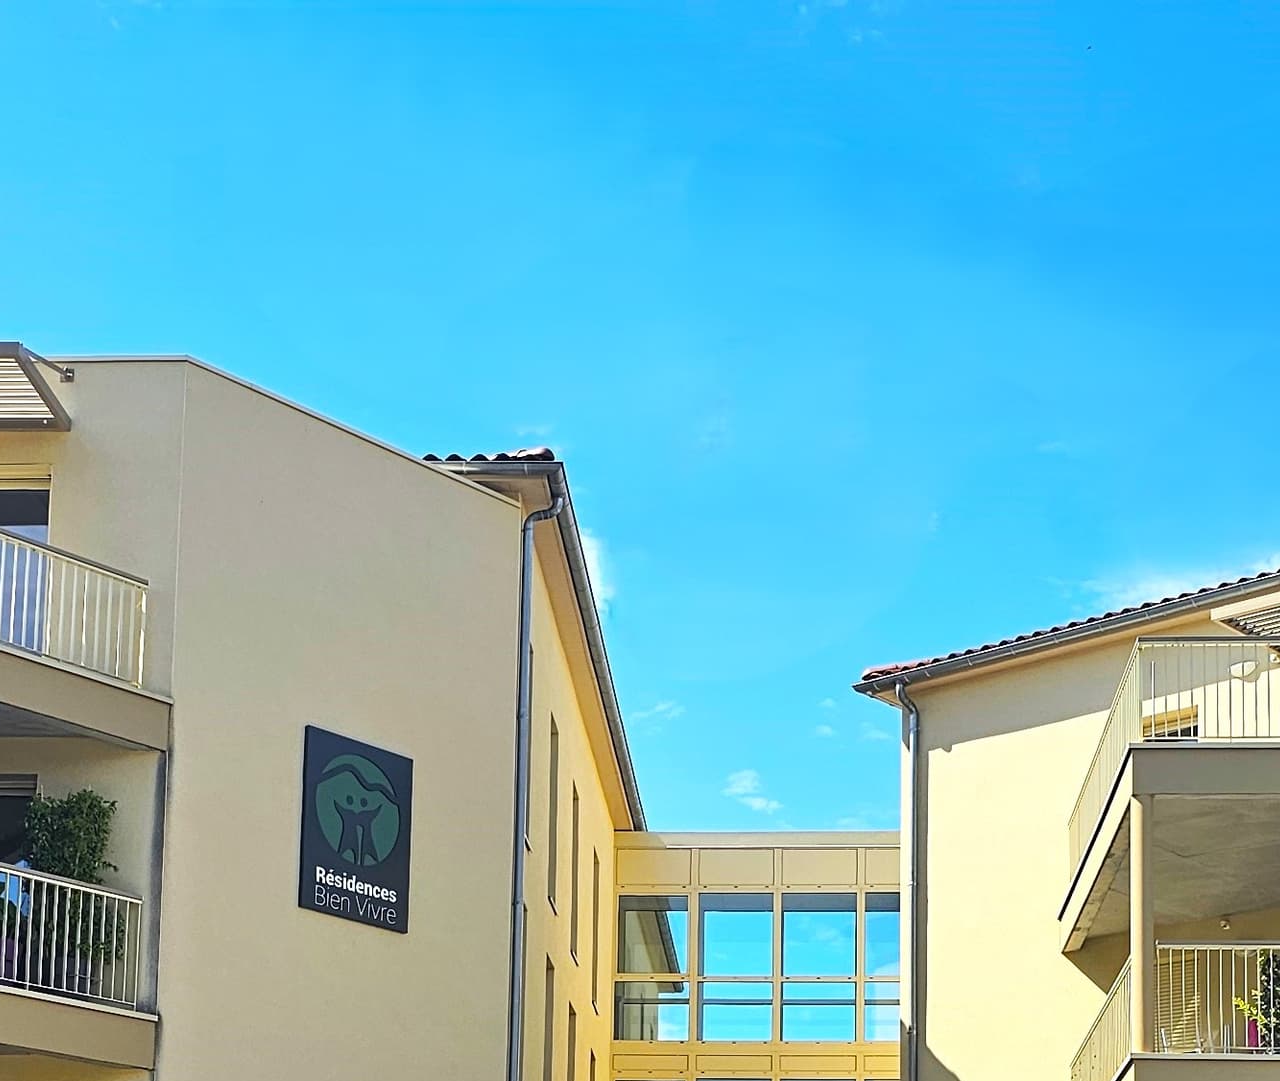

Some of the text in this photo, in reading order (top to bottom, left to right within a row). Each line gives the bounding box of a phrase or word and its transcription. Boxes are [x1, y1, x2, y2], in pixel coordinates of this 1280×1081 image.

[315, 866, 397, 903] Résidences
[314, 884, 397, 925] Bien Vivre
